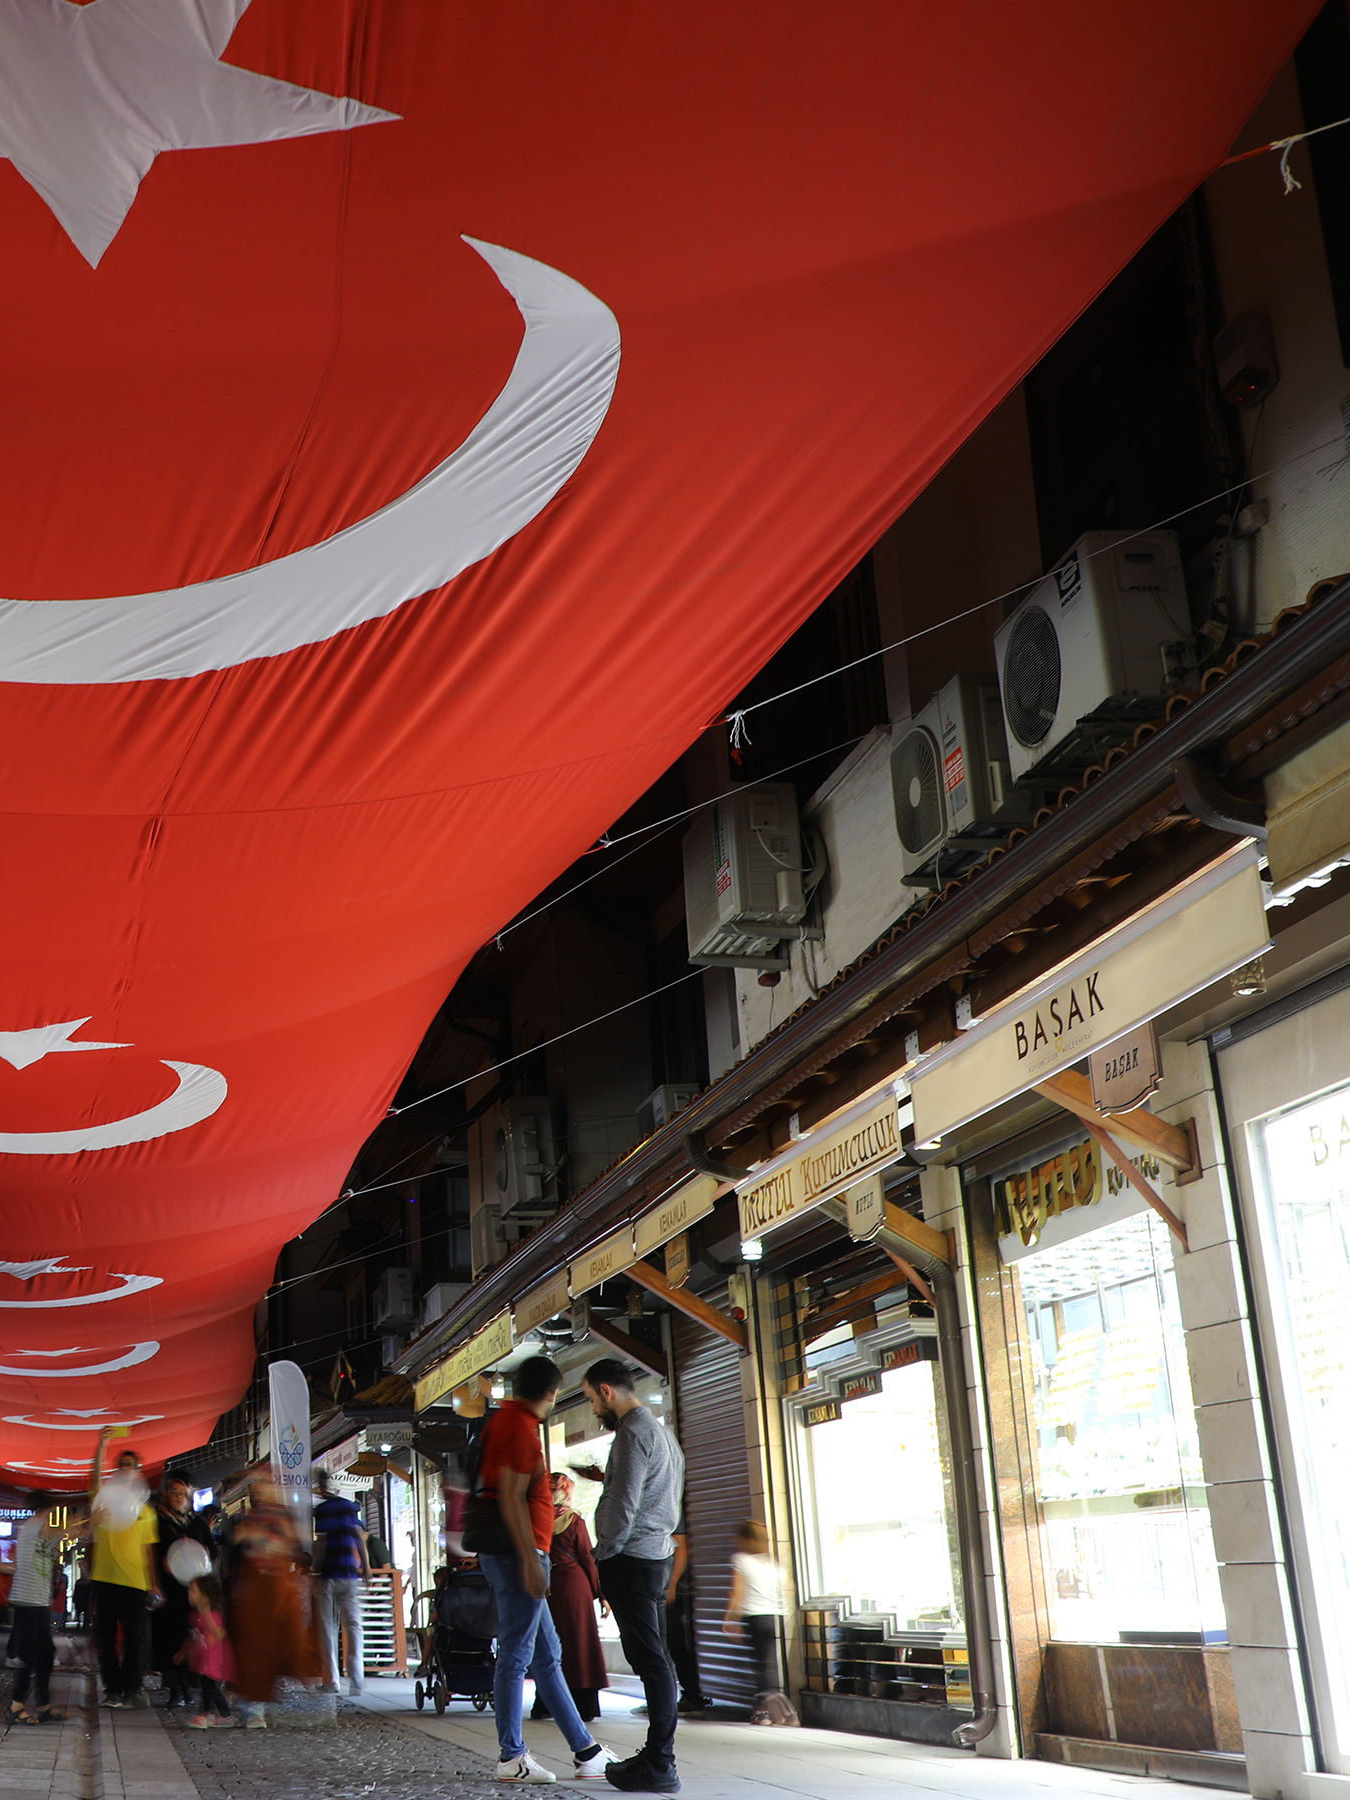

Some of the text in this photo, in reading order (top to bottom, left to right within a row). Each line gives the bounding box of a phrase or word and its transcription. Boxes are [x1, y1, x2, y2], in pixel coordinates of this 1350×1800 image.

[1014, 971, 1104, 1061] BAŞAK
[1105, 1047, 1138, 1083] BAŞAK
[367, 1430, 411, 1442] UYAROĞLU
